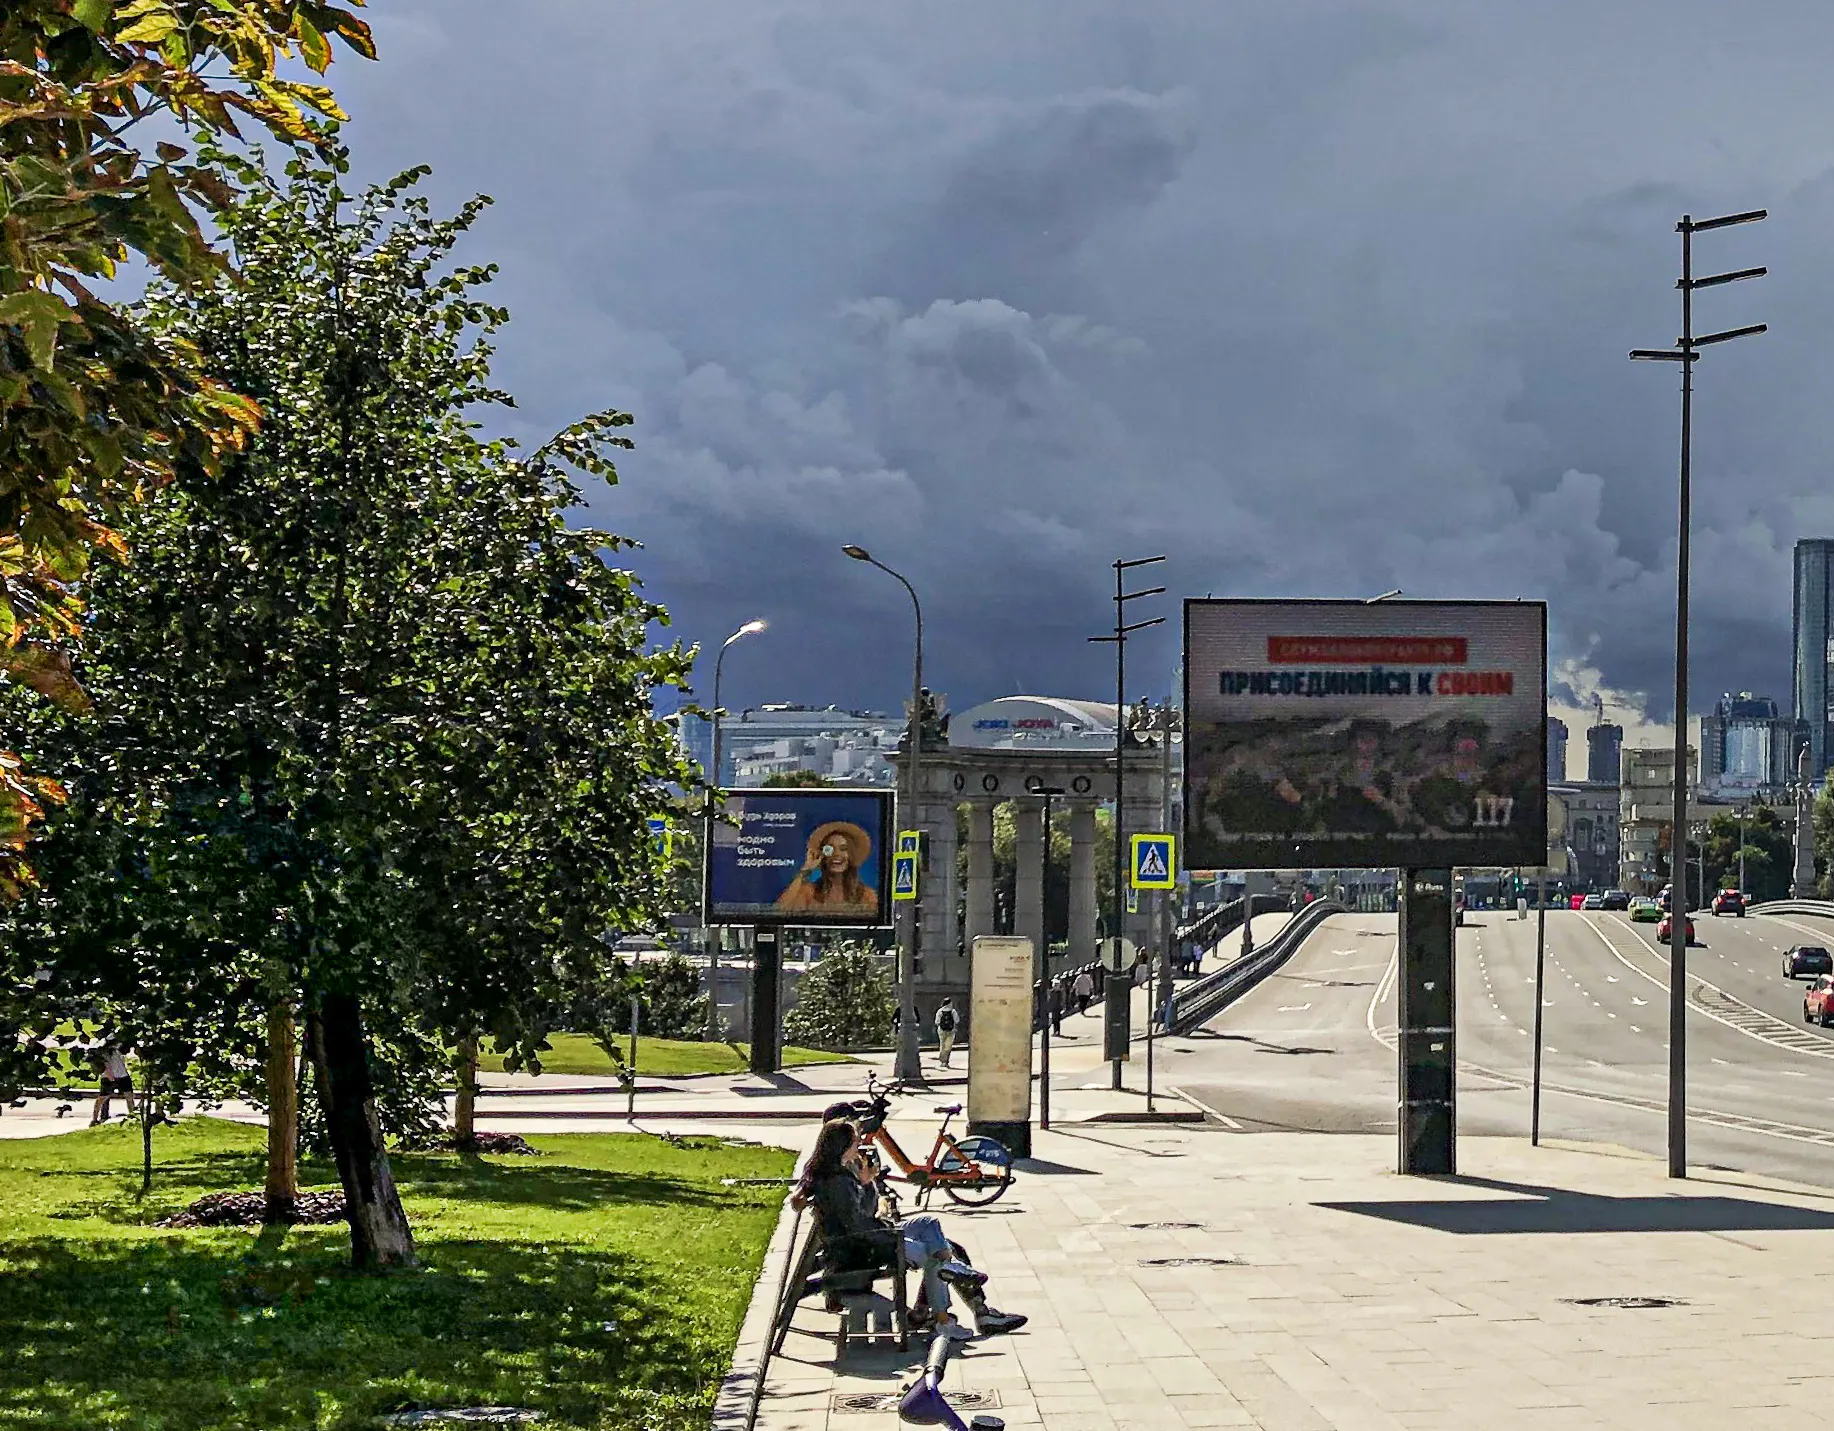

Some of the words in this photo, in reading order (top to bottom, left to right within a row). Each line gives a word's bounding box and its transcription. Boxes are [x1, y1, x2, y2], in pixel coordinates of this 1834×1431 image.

[1220, 665, 1411, 696] ПРИСОЕДИНЯЙСЯ
[1418, 672, 1433, 695] К
[1437, 672, 1514, 695] СВОИМ
[737, 845, 765, 855] быть
[737, 859, 795, 868] здоровым
